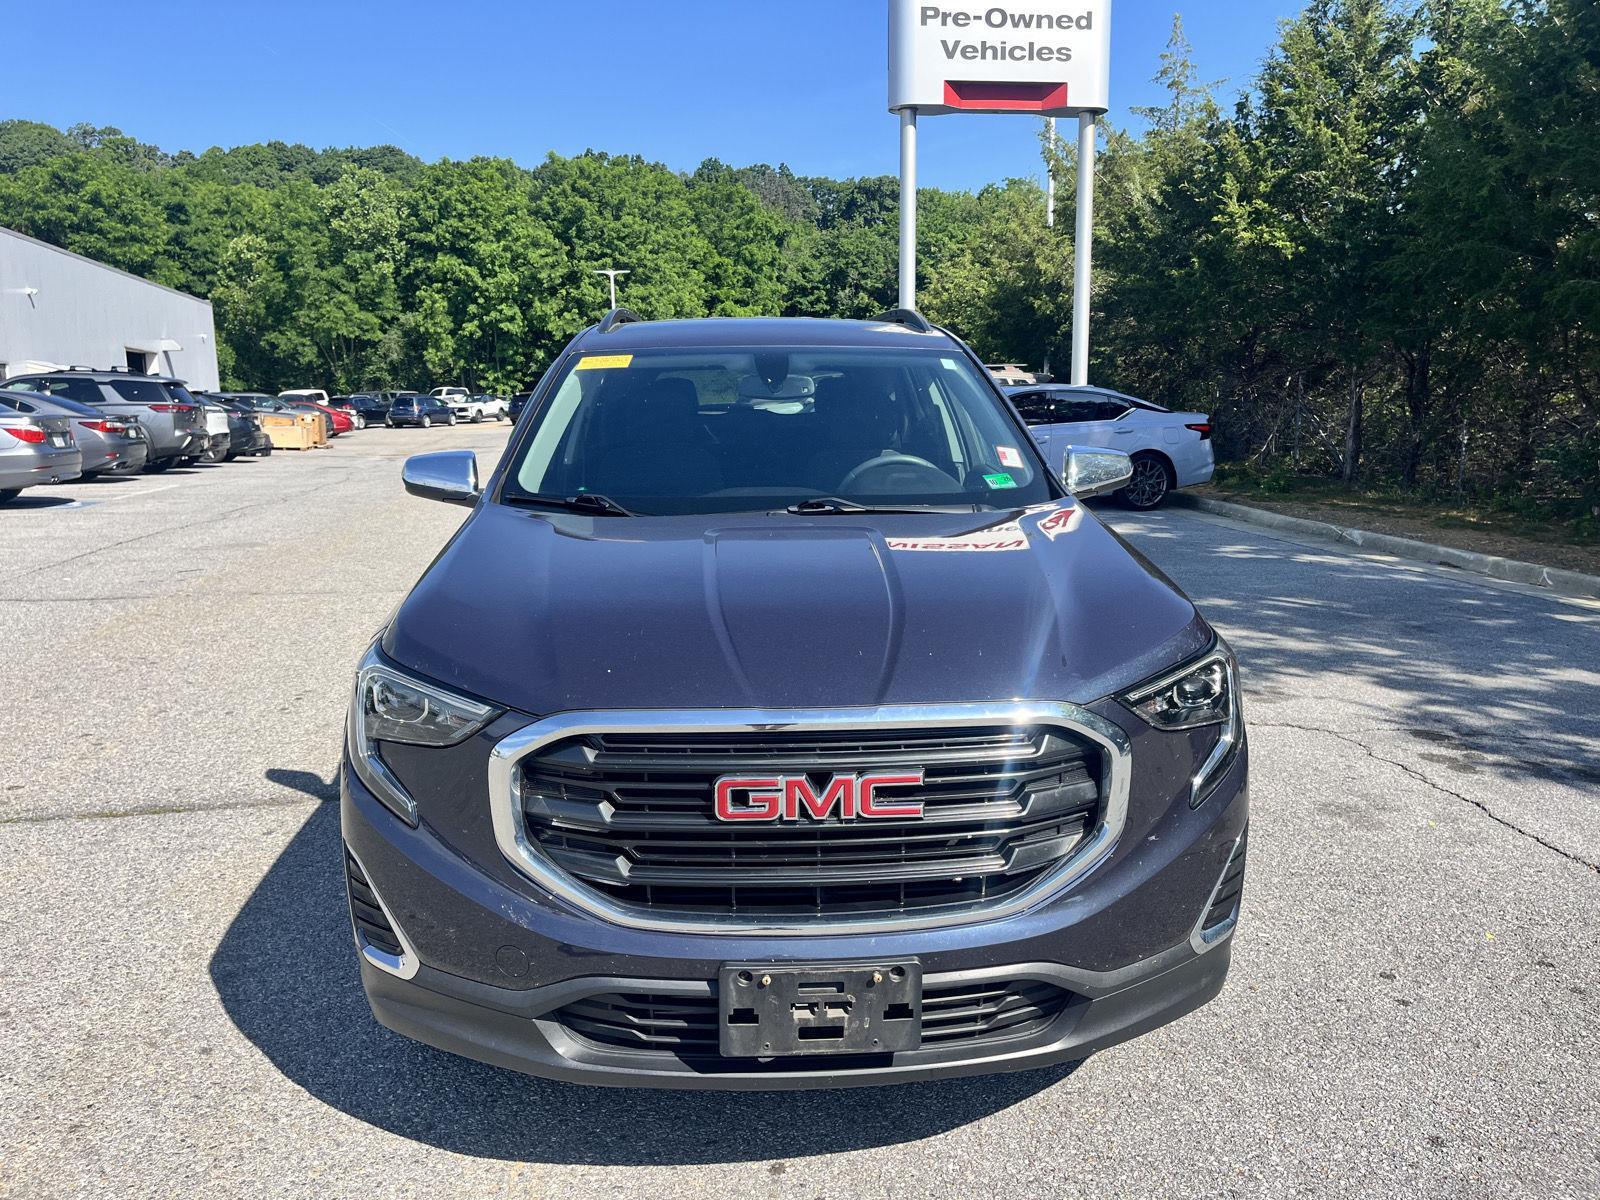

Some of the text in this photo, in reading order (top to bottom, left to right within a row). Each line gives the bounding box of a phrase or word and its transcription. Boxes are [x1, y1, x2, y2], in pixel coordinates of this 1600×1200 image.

[920, 6, 1093, 30] Pre-Owned
[940, 39, 1072, 62] Vehicles
[714, 769, 925, 821] GMC
